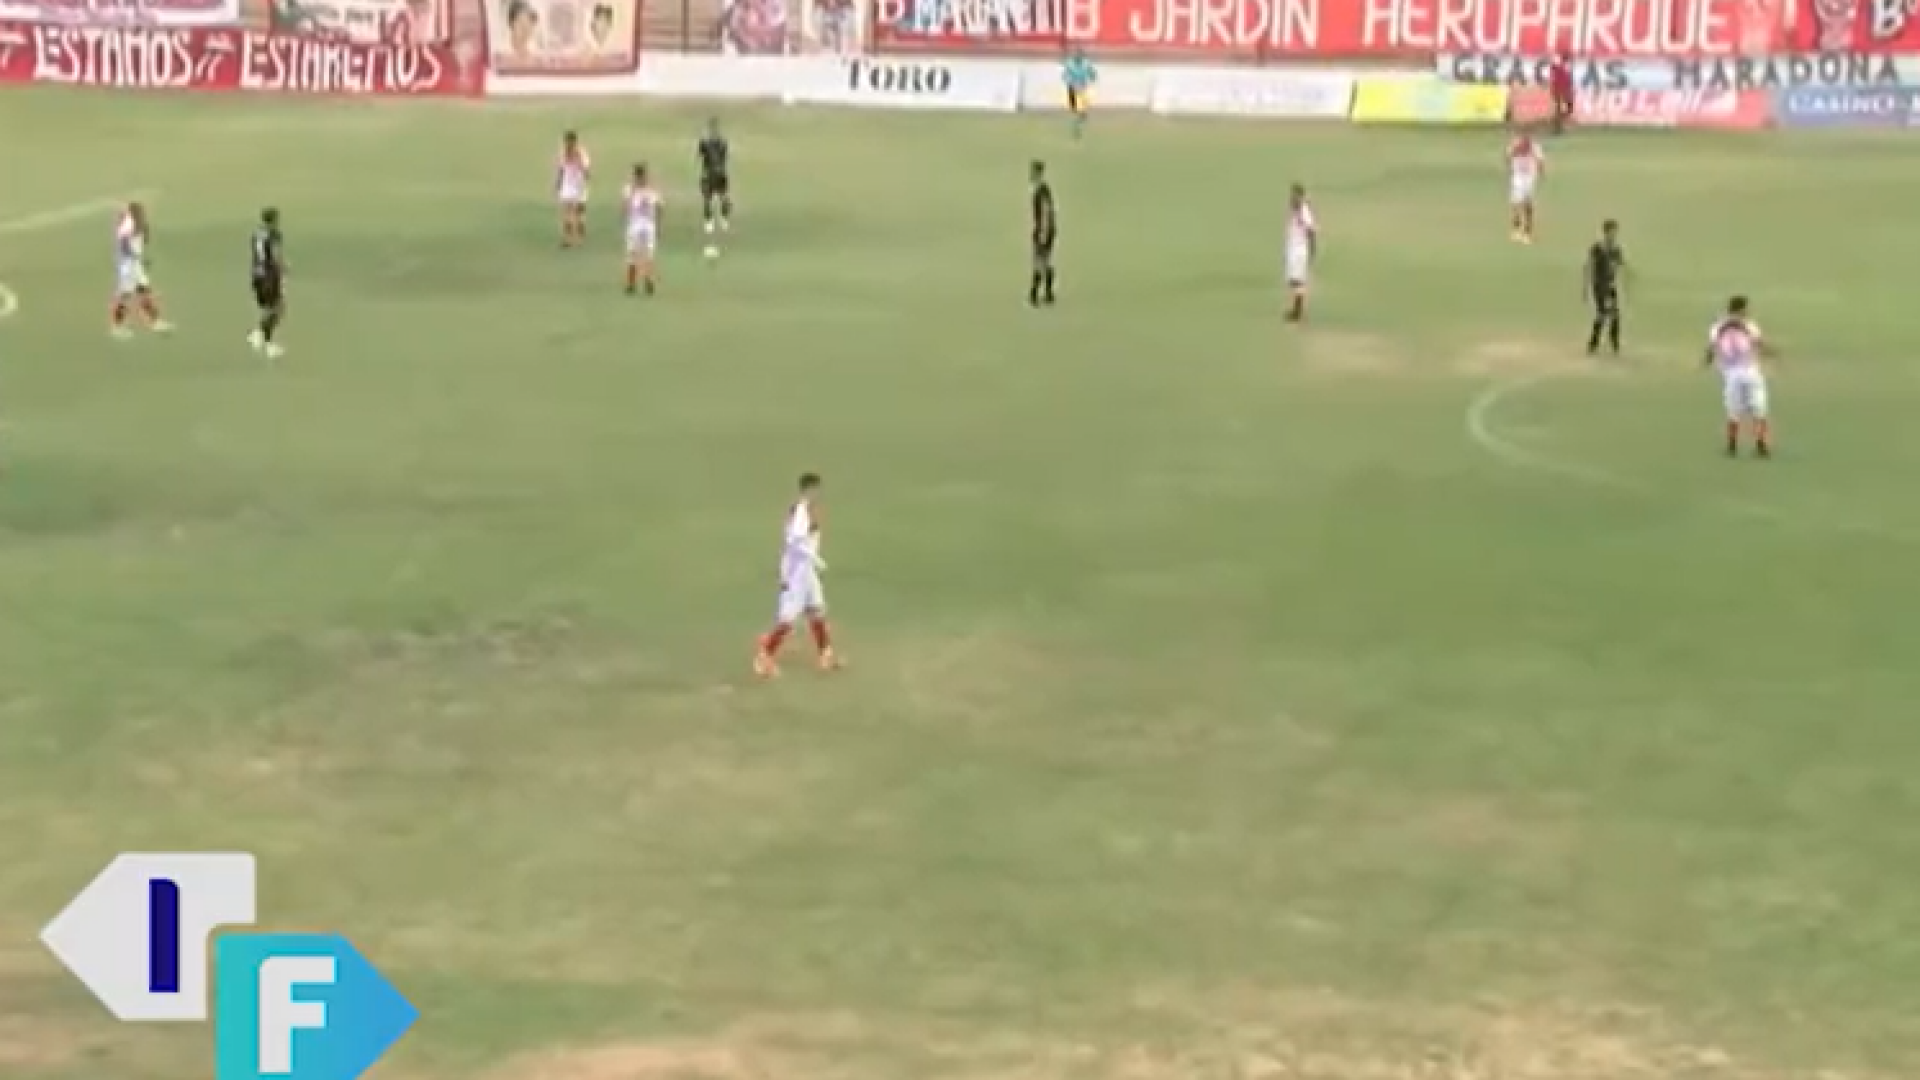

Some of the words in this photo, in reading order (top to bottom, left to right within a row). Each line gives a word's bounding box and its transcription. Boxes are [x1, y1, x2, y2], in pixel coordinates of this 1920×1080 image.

[33, 26, 192, 87] ESTAMOS
[840, 57, 951, 92] TORO
[1453, 55, 1629, 92] GRACAS
[1673, 53, 1897, 92] MARADONA
